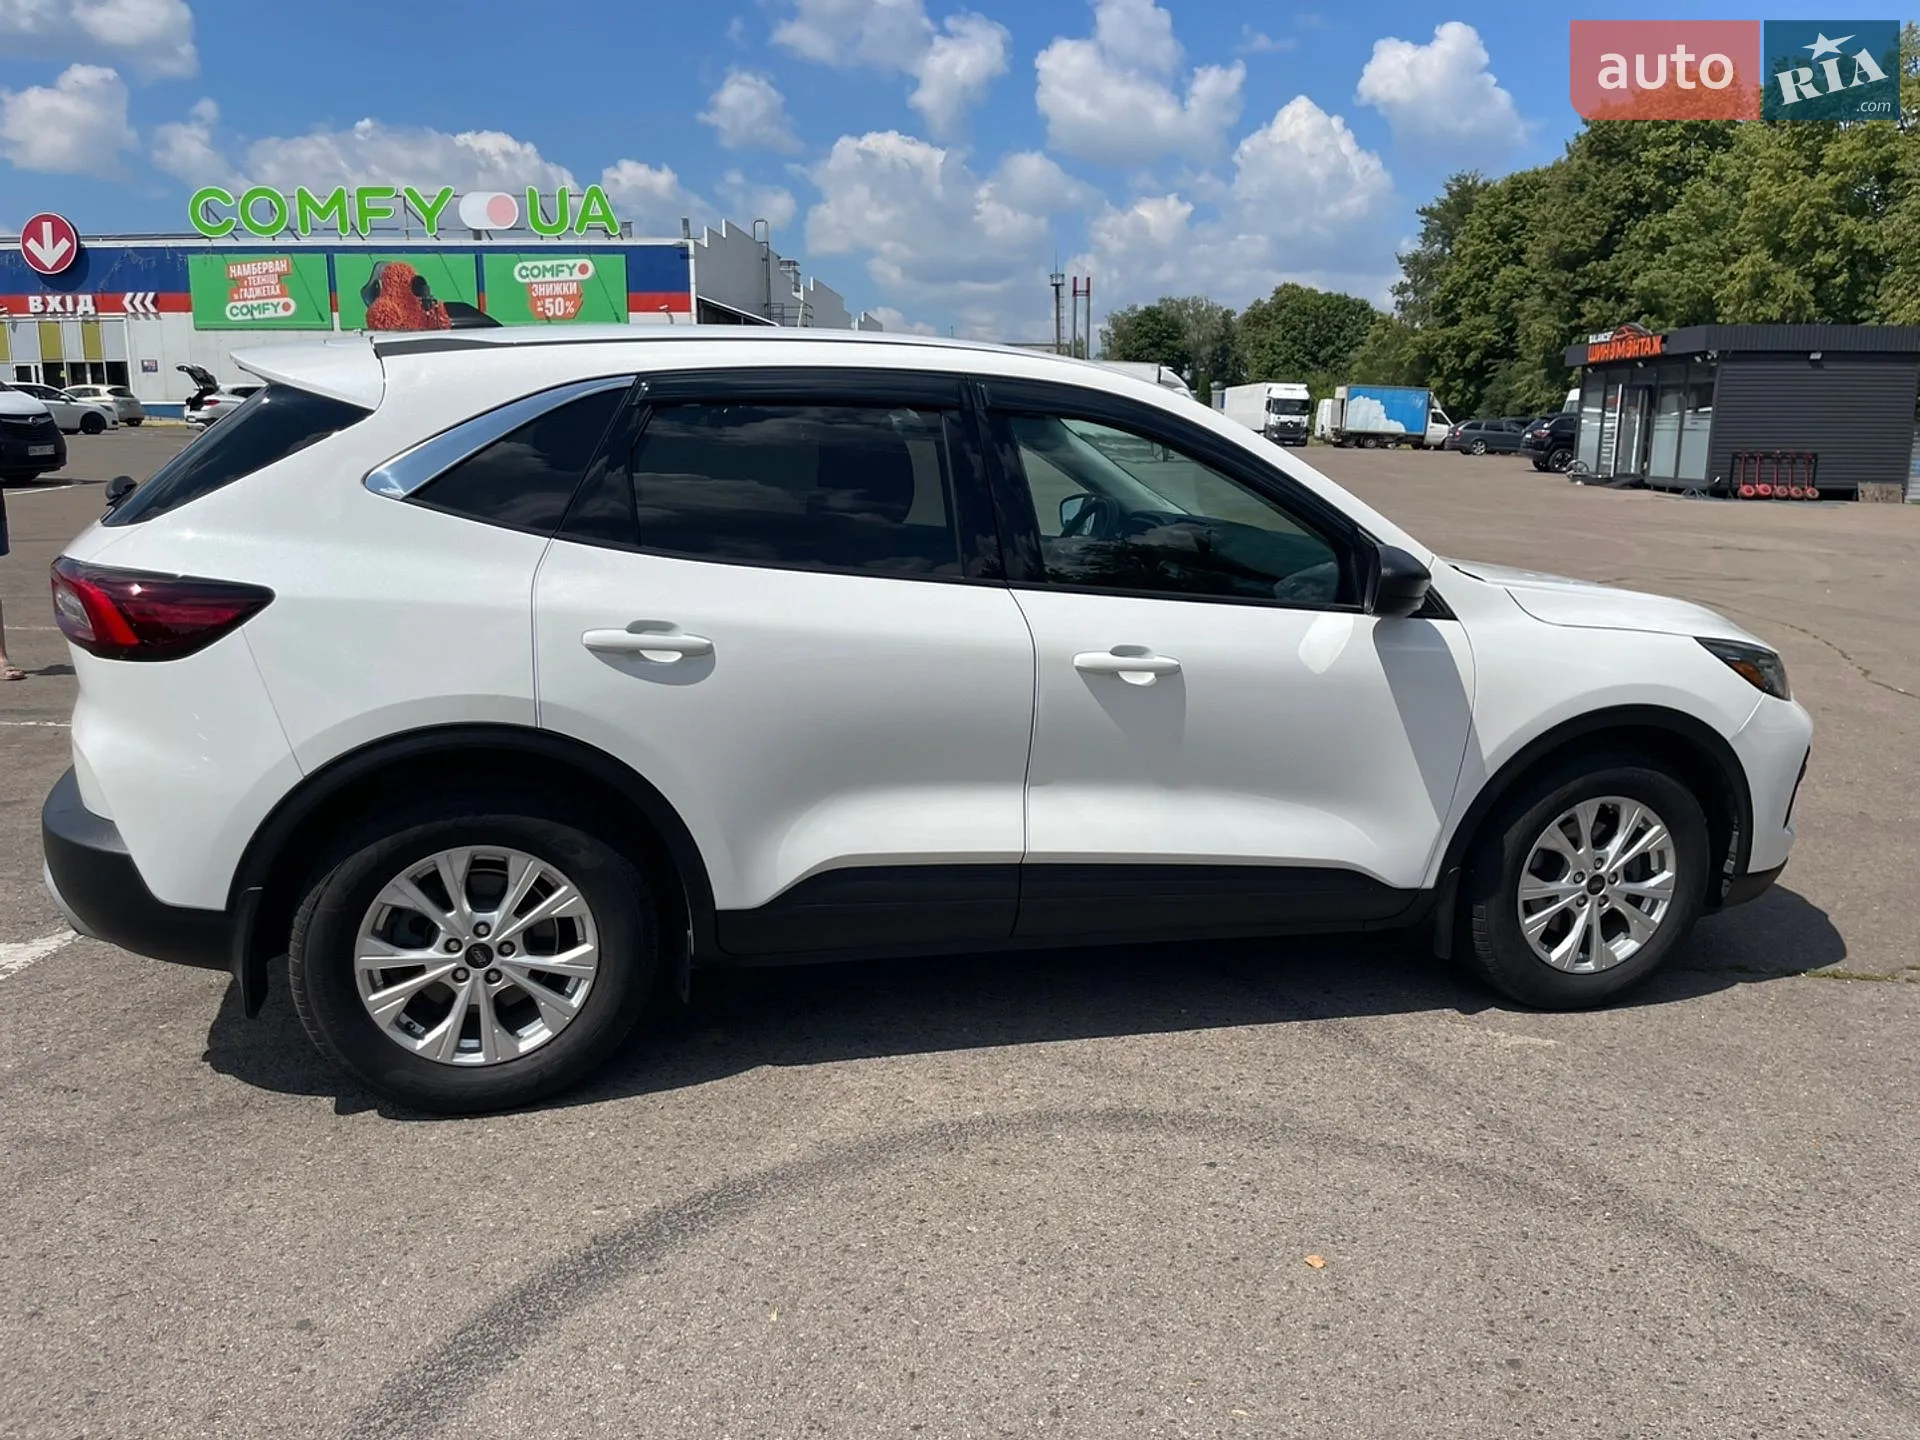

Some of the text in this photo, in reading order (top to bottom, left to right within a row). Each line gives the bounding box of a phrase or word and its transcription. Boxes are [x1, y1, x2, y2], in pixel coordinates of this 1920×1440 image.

[188, 184, 621, 238] COMFY UA
[229, 259, 288, 278] НАМБЕРВАН
[518, 263, 577, 279] COMFY
[531, 282, 577, 297] ЗНИЖКИ
[28, 294, 96, 316] ВХІД
[229, 302, 280, 318] COMFY
